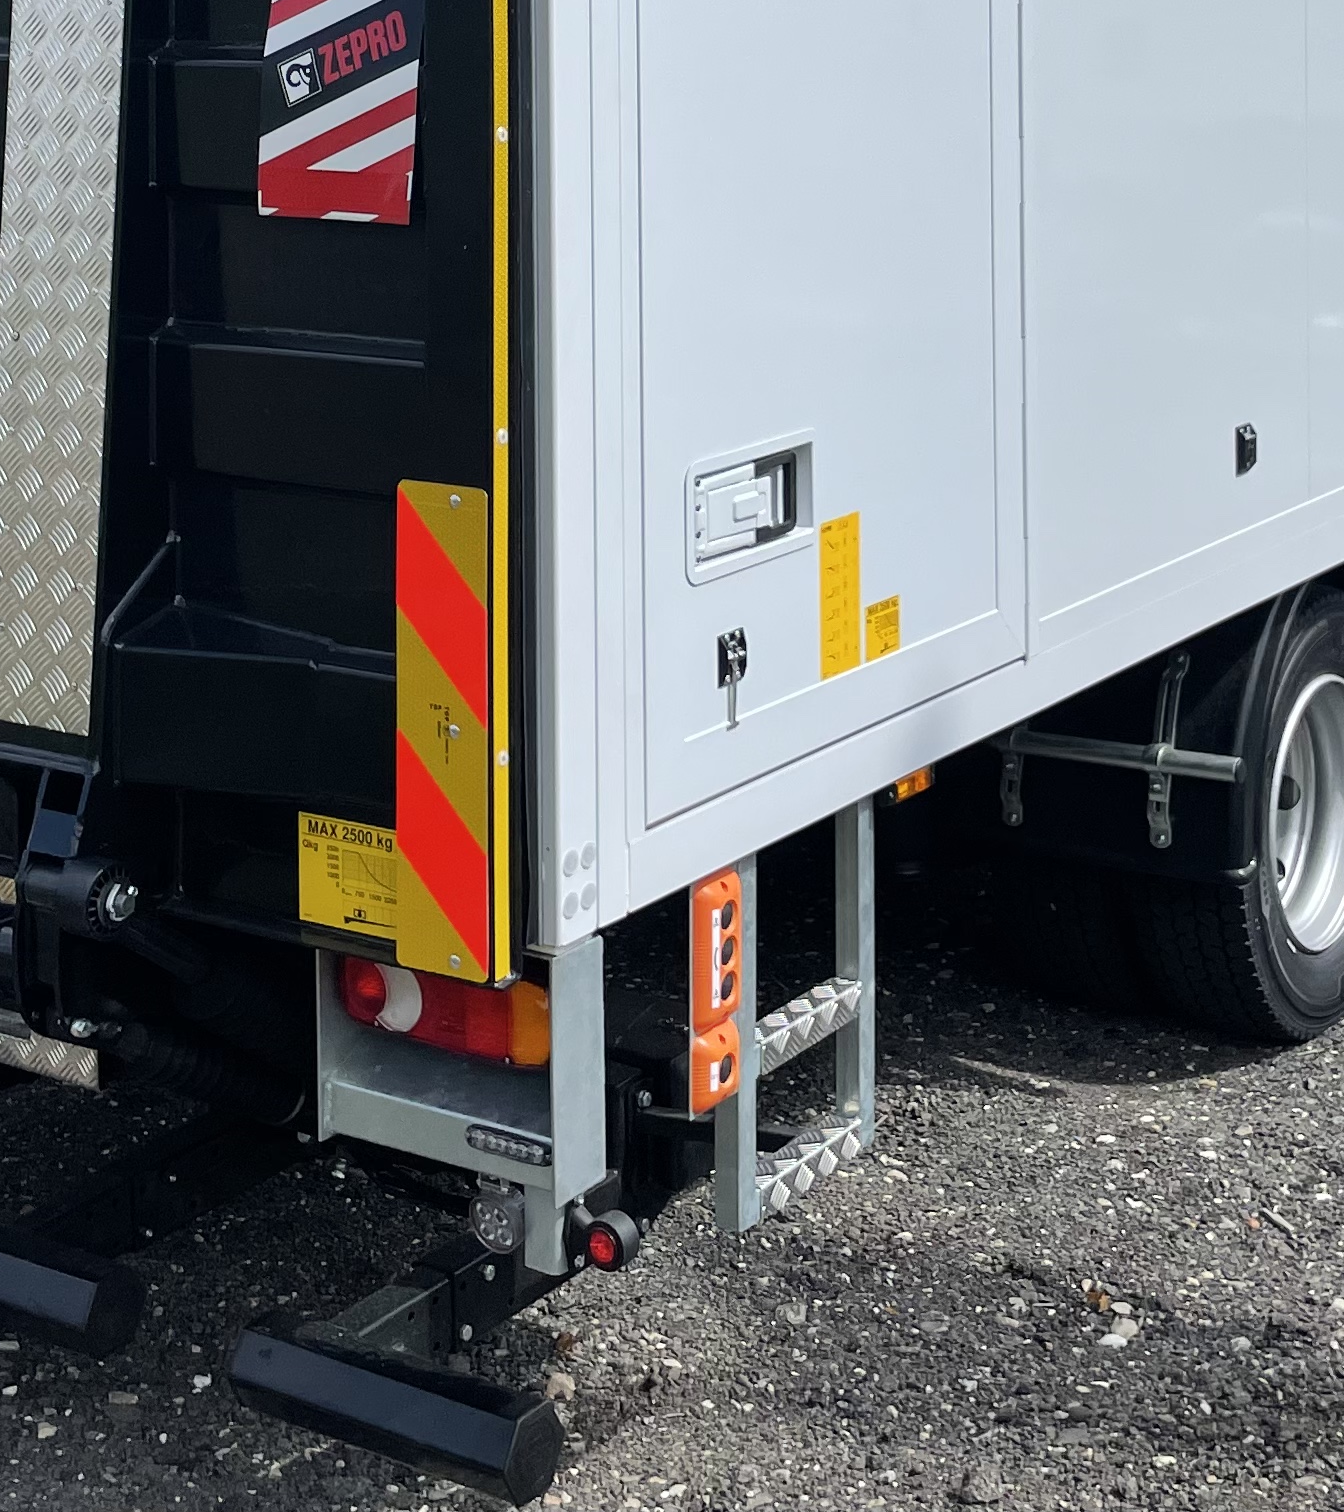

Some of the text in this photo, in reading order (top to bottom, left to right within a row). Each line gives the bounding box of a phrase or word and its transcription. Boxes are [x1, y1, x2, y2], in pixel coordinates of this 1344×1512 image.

[318, 10, 406, 85] ZEPRO
[308, 819, 393, 853] MAX 2500 kg
